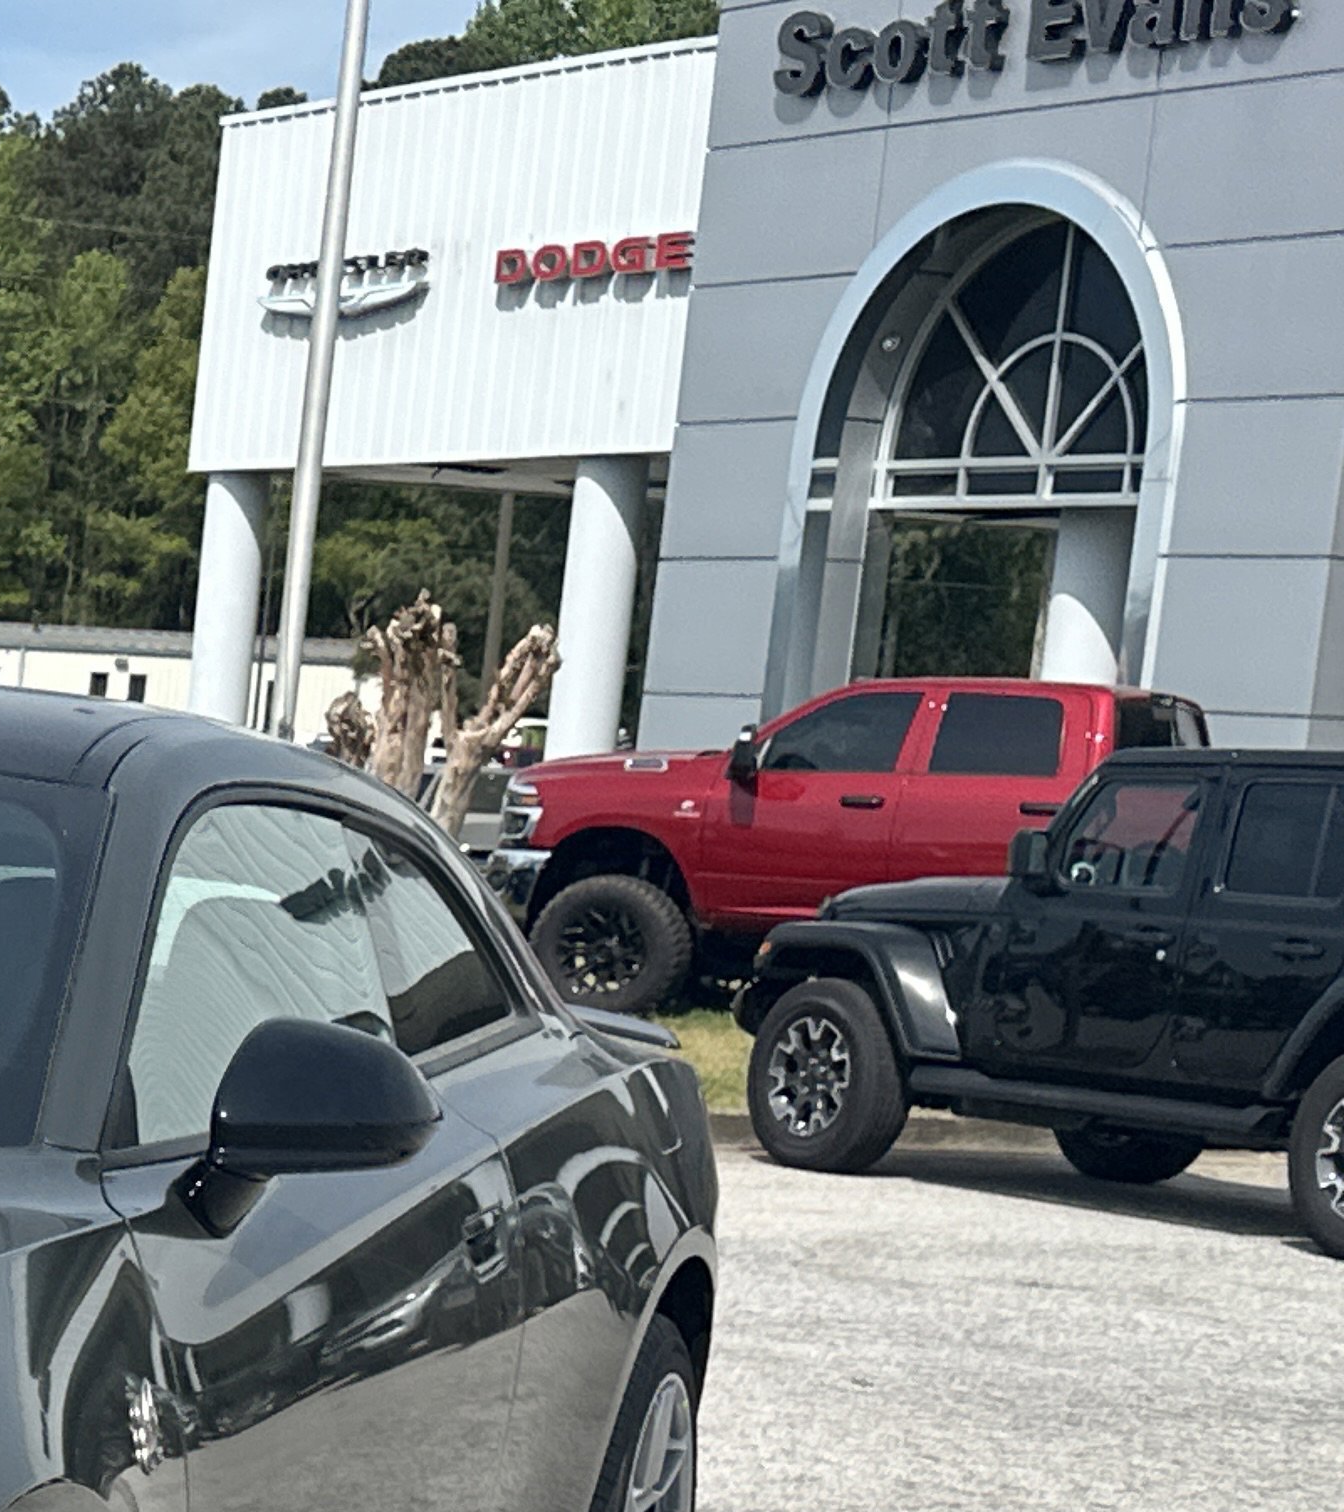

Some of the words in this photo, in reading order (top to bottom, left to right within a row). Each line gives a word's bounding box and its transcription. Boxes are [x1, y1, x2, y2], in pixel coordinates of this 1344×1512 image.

[773, 0, 1009, 97] Scott
[266, 248, 430, 282] CHRSLER
[495, 230, 695, 284] DODGE
